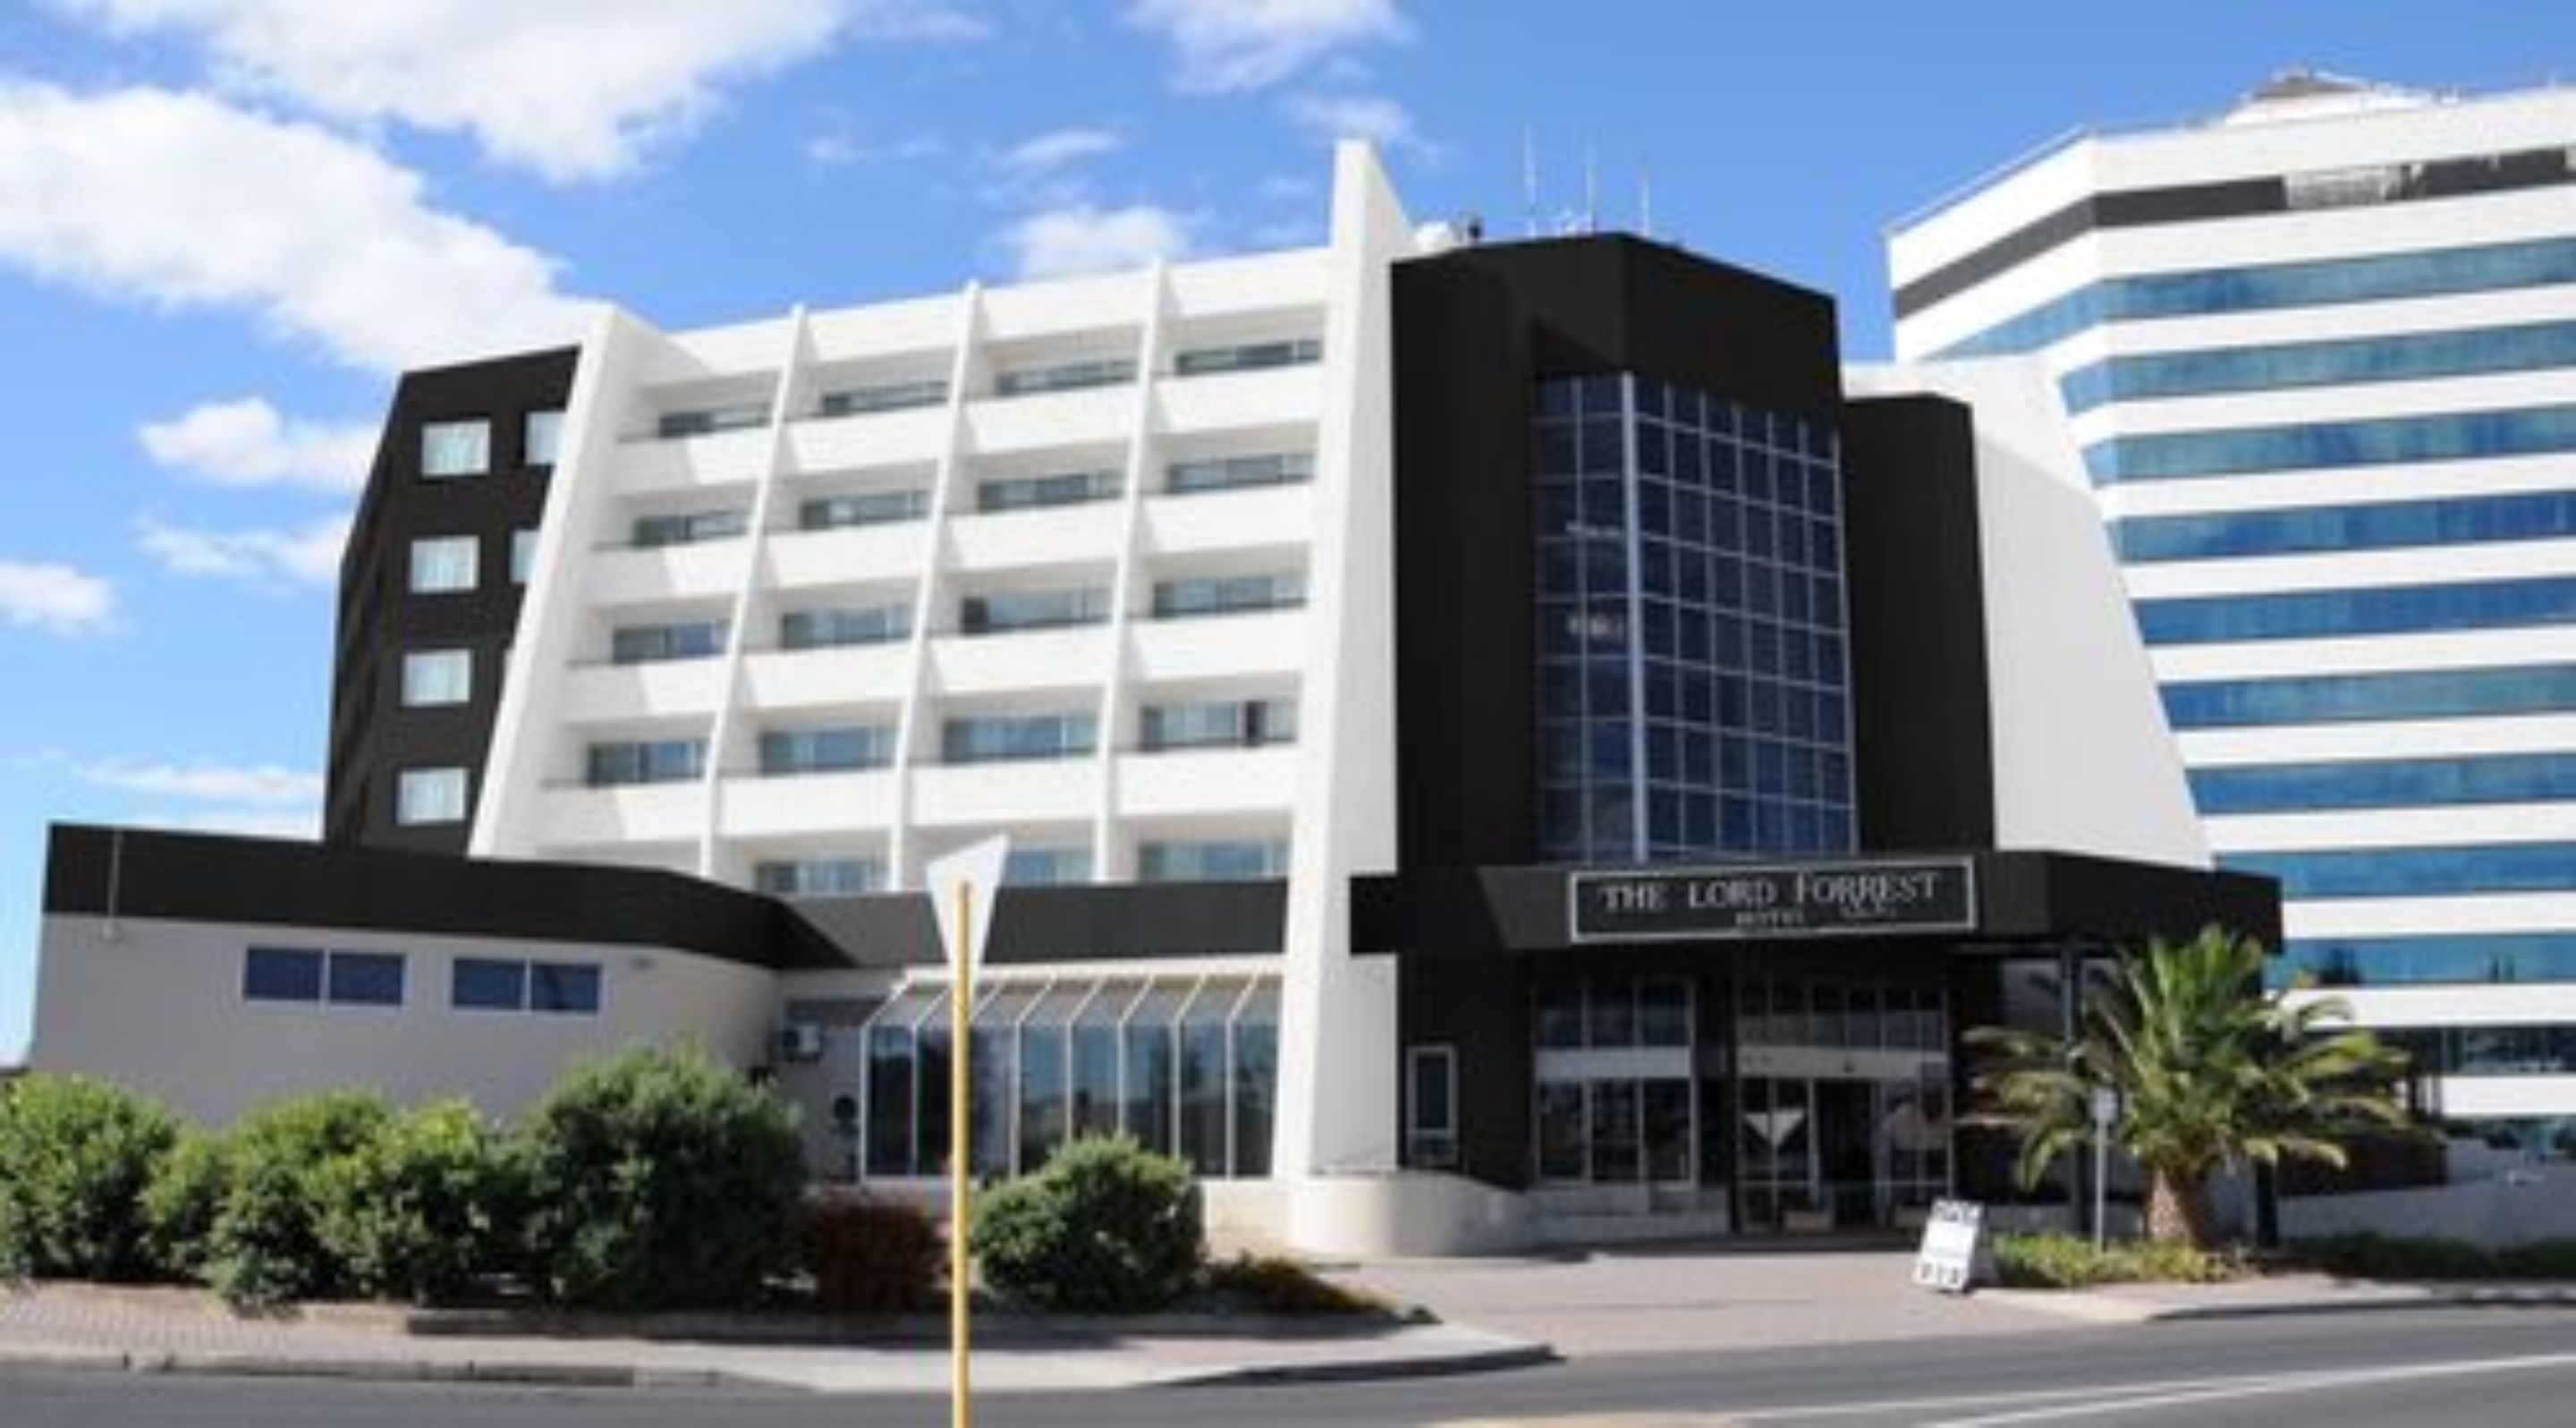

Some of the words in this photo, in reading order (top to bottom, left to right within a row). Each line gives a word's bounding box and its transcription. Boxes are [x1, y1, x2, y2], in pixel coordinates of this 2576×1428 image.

[1599, 884, 1666, 911] THE
[1688, 879, 1777, 910] LORD
[1796, 870, 1941, 906] FORREST
